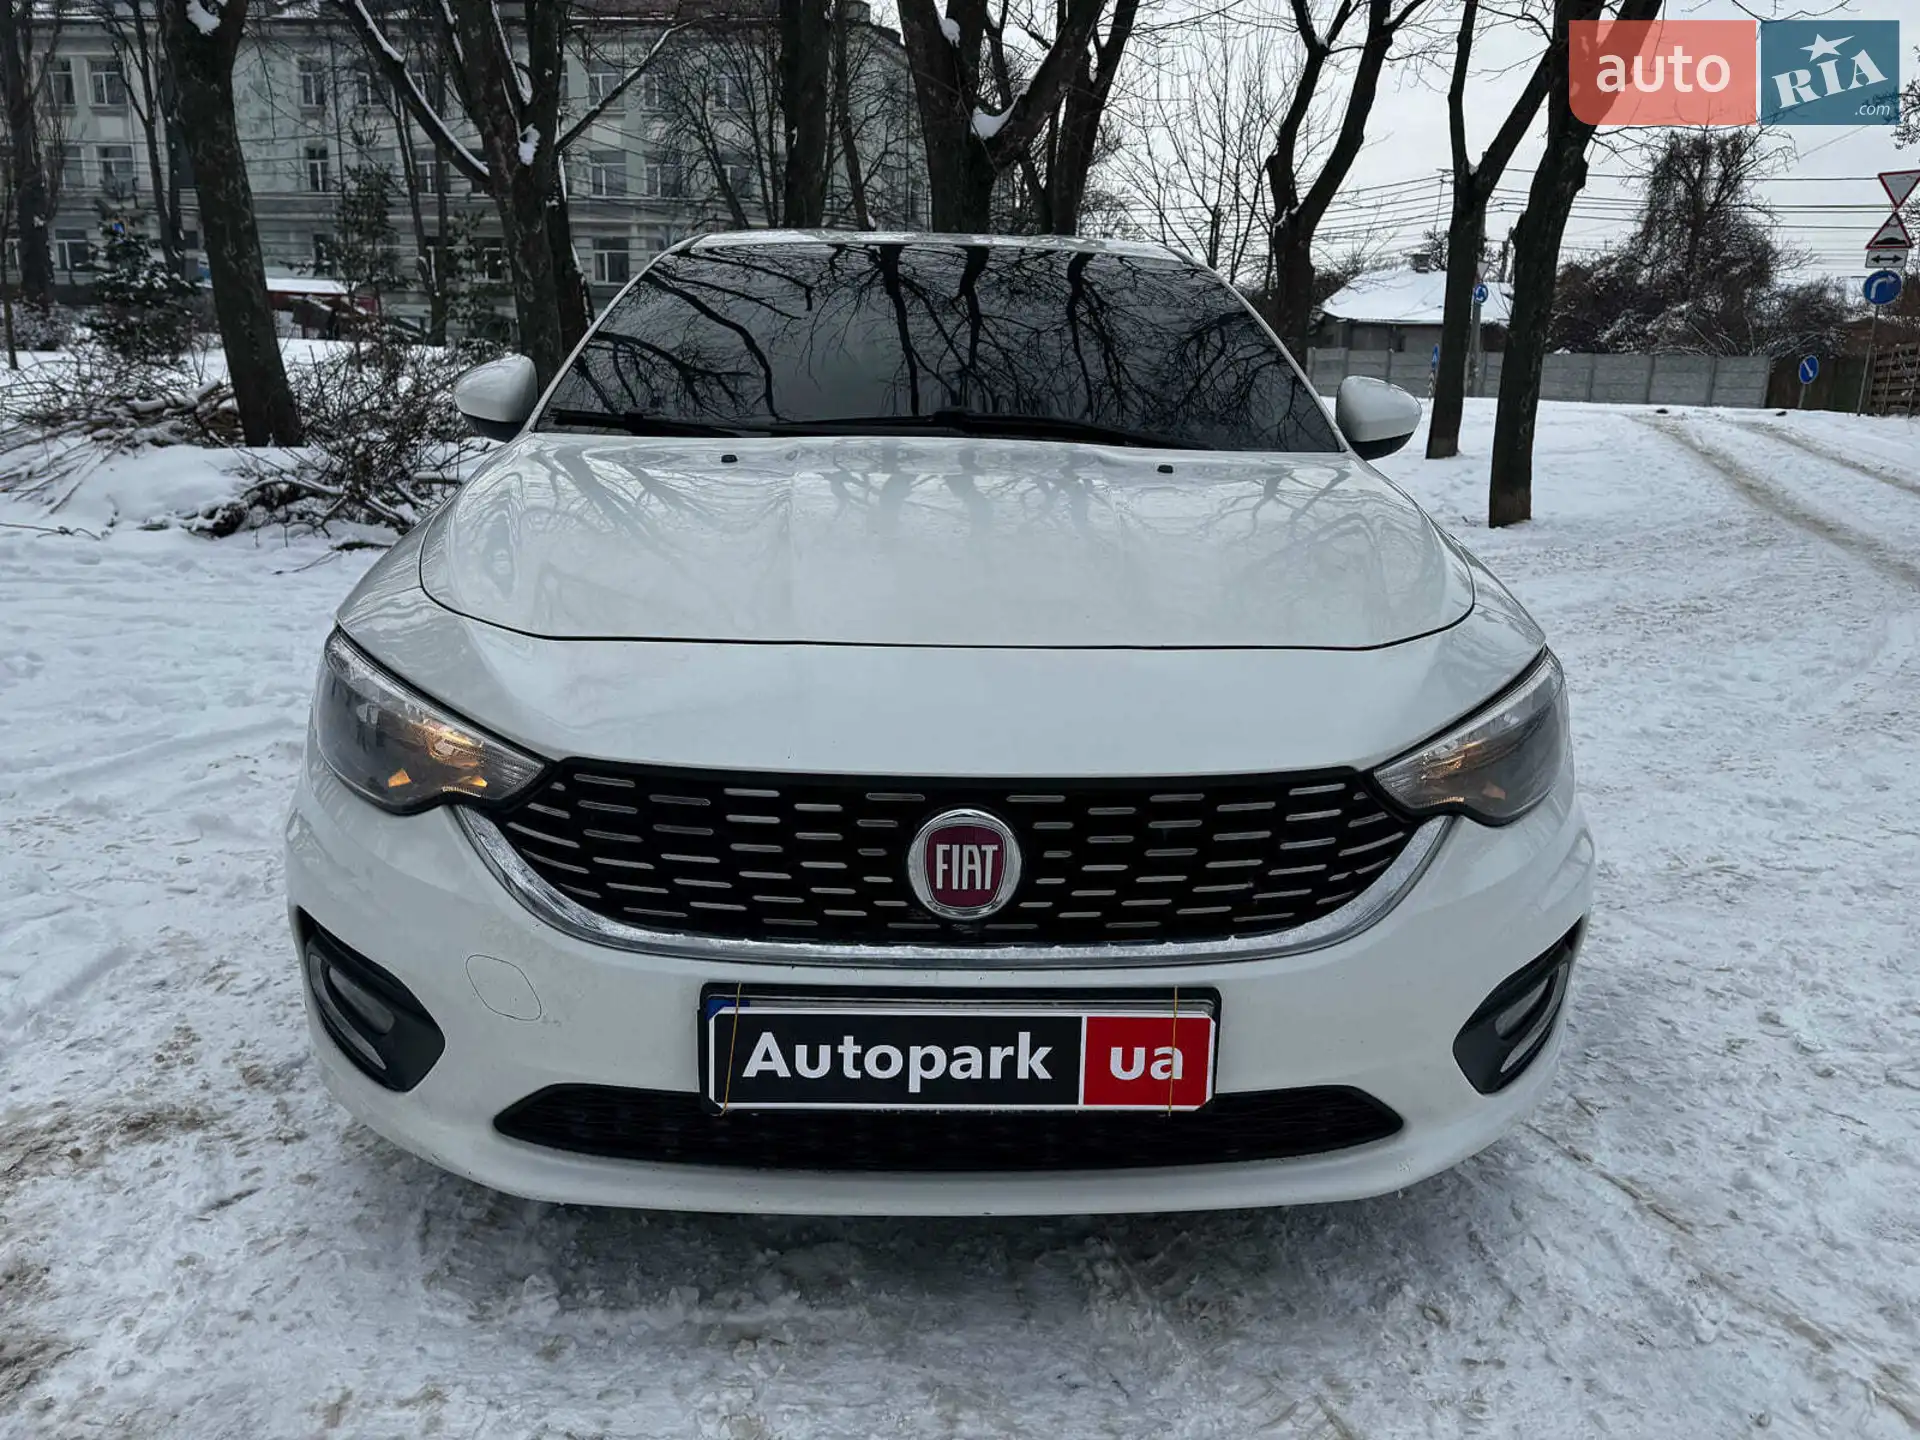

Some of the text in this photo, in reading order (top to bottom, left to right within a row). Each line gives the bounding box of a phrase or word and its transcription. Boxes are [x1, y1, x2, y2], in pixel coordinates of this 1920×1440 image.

[936, 844, 999, 890] FIAT
[742, 1031, 1183, 1093] Autopark ua
